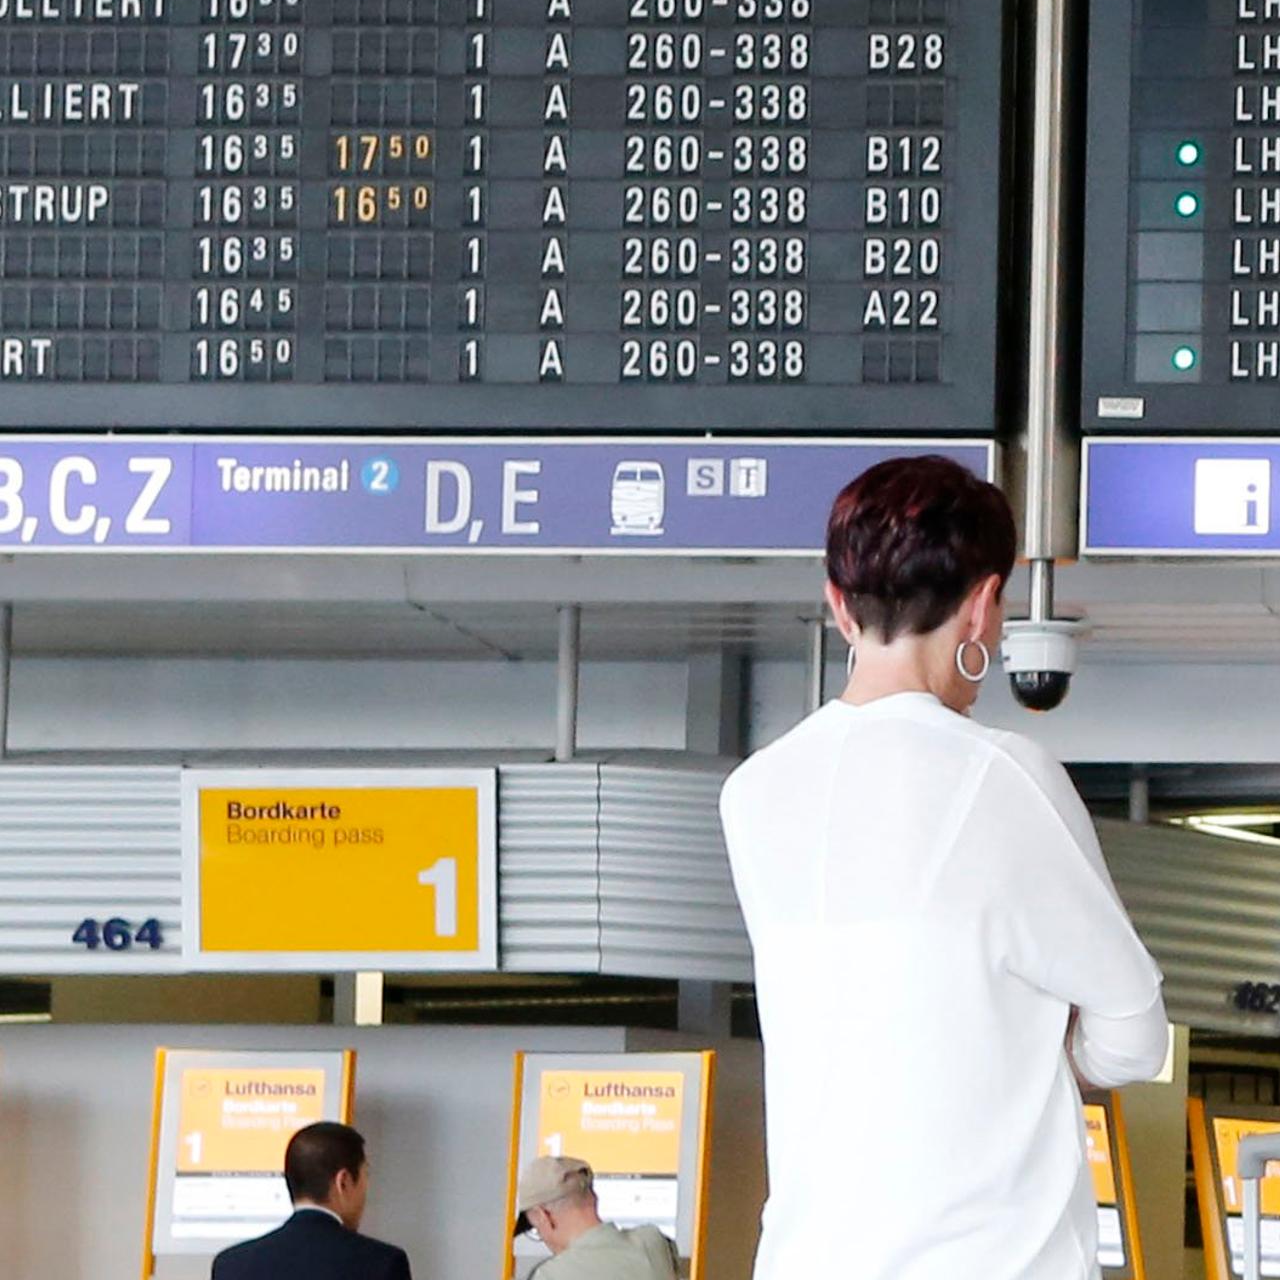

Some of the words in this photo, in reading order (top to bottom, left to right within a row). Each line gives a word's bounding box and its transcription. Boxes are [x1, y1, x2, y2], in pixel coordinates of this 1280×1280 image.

[870, 34, 942, 69] B28
[868, 137, 939, 171] B12
[867, 187, 938, 222] B10
[866, 239, 938, 274] B20
[864, 290, 937, 325] A22
[217, 458, 348, 491] Terminal
[370, 461, 389, 490] 2
[425, 460, 540, 543] D,E
[227, 801, 341, 820] Bordkarte
[227, 823, 325, 848] Boarding
[334, 829, 384, 846] pass
[418, 857, 457, 938] 1
[72, 916, 163, 951] 464
[224, 1080, 317, 1097] Lufthansa
[583, 1082, 676, 1098] Lufthansa
[184, 1130, 205, 1164] 1
